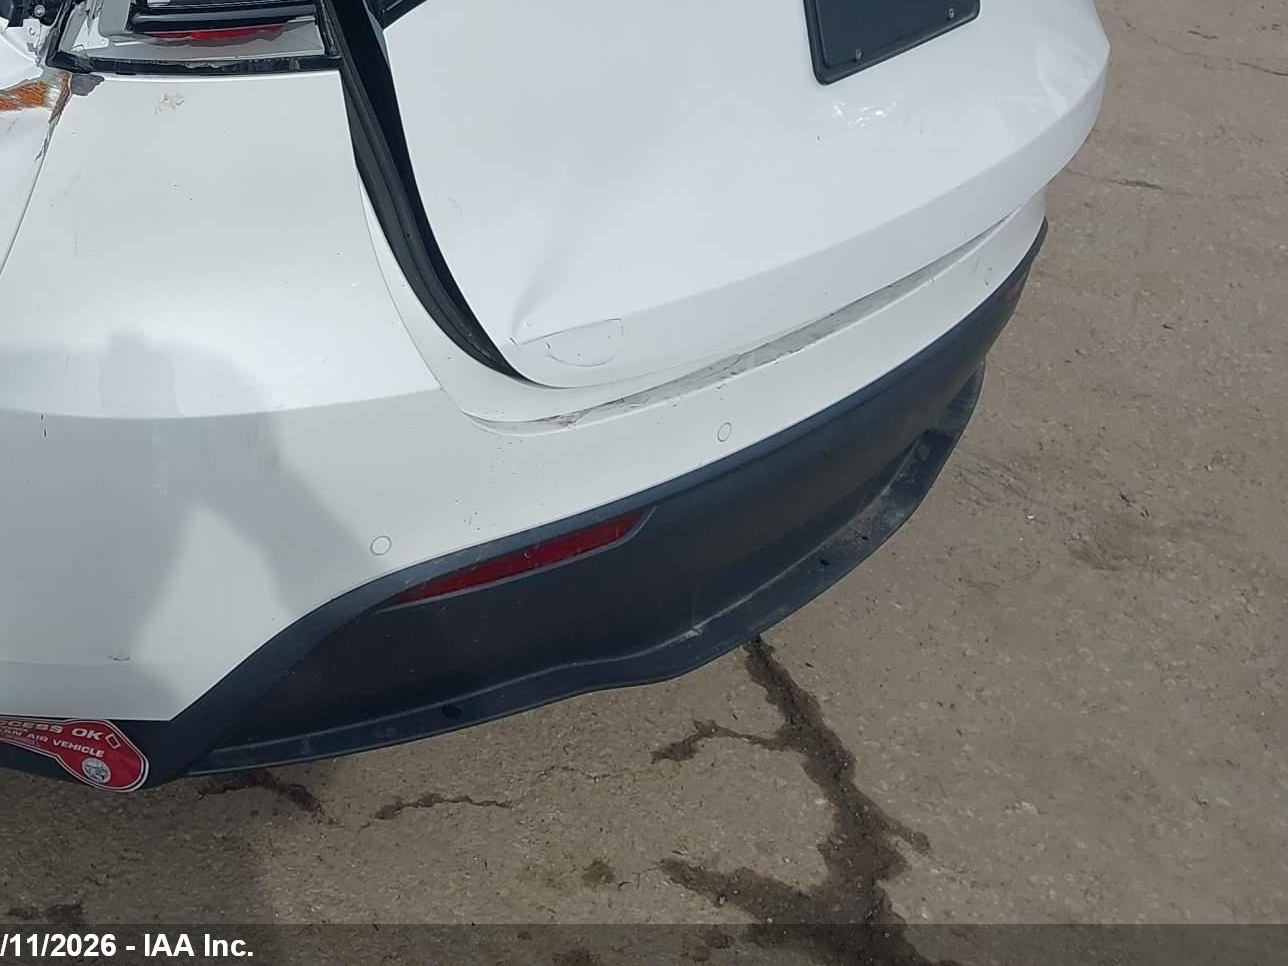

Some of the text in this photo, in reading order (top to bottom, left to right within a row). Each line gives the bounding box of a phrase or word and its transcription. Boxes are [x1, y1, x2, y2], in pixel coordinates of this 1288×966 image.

[71, 728, 105, 741] OK
[26, 733, 49, 743] AIR
[52, 739, 105, 758] VEHICLE
